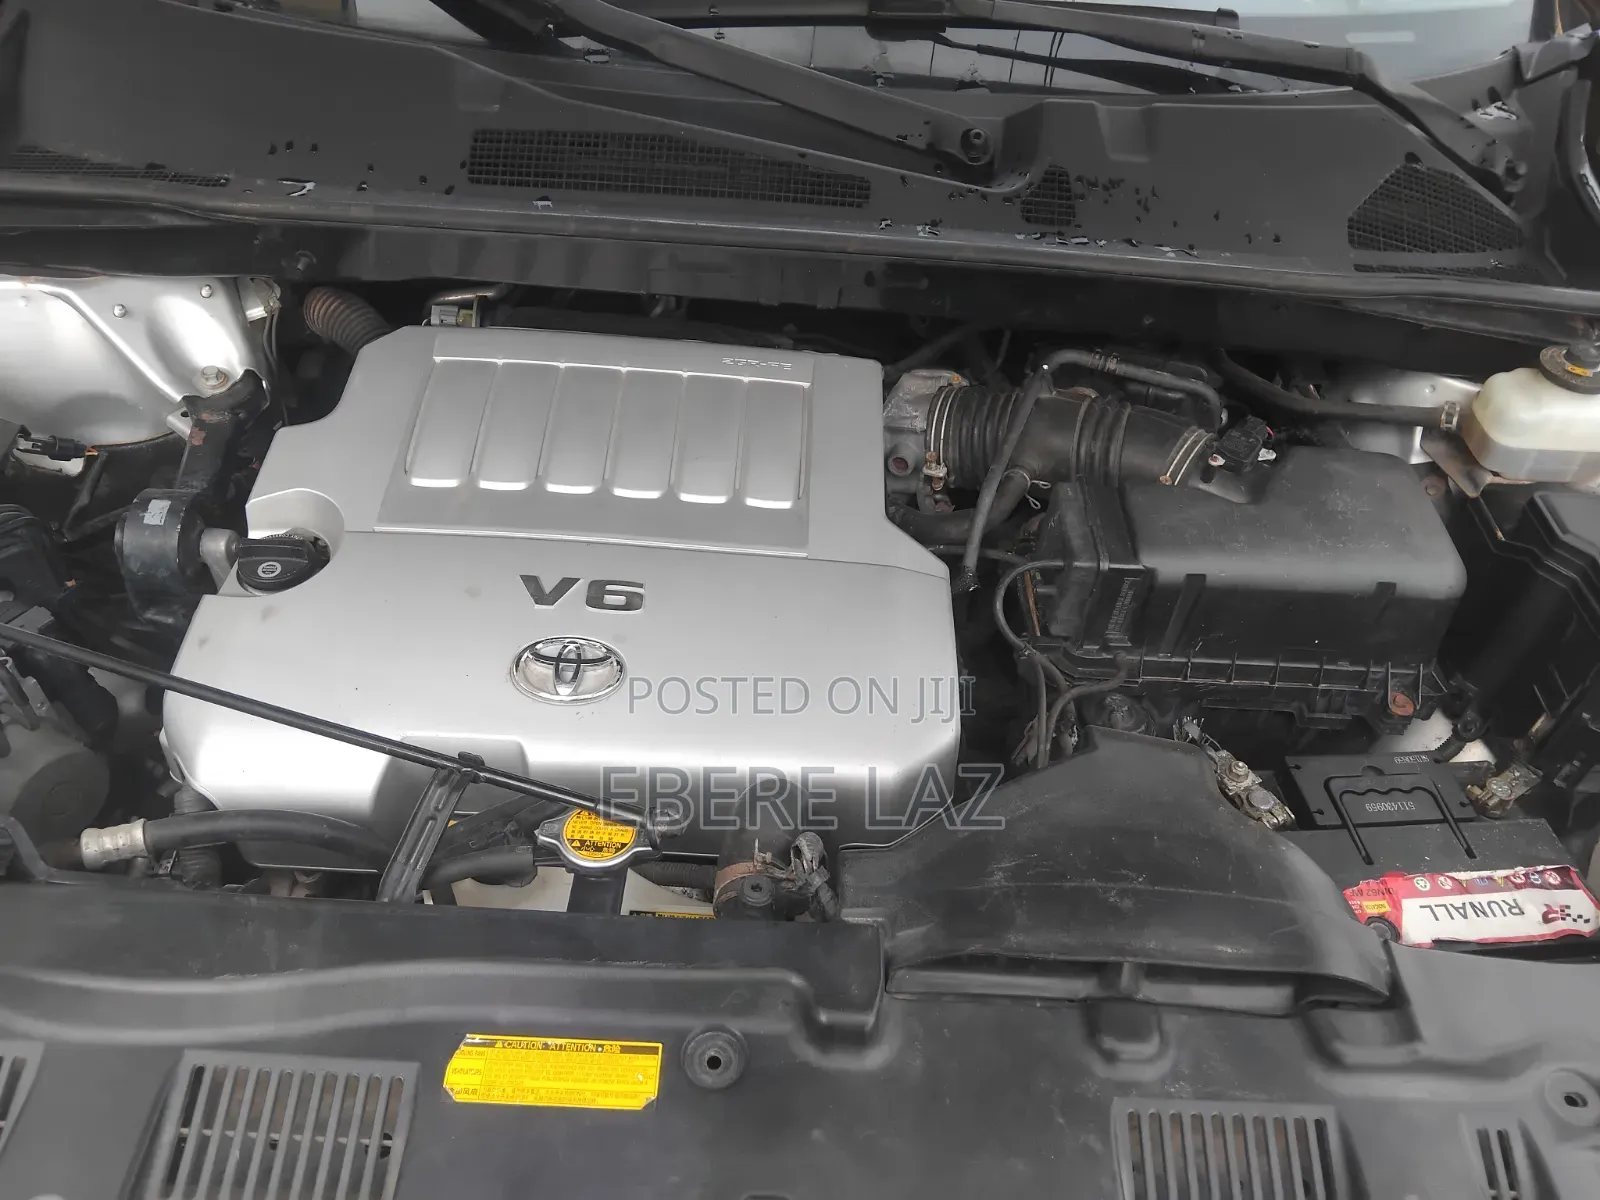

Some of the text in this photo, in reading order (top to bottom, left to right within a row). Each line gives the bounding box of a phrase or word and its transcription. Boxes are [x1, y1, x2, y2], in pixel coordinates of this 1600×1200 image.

[519, 574, 645, 614] V6
[1365, 801, 1416, 812] 511430959
[584, 840, 622, 849] ATTENTION
[1419, 898, 1525, 922] RUNALL
[505, 1040, 543, 1050] CAUTION
[549, 1041, 597, 1053] ATTENTION
